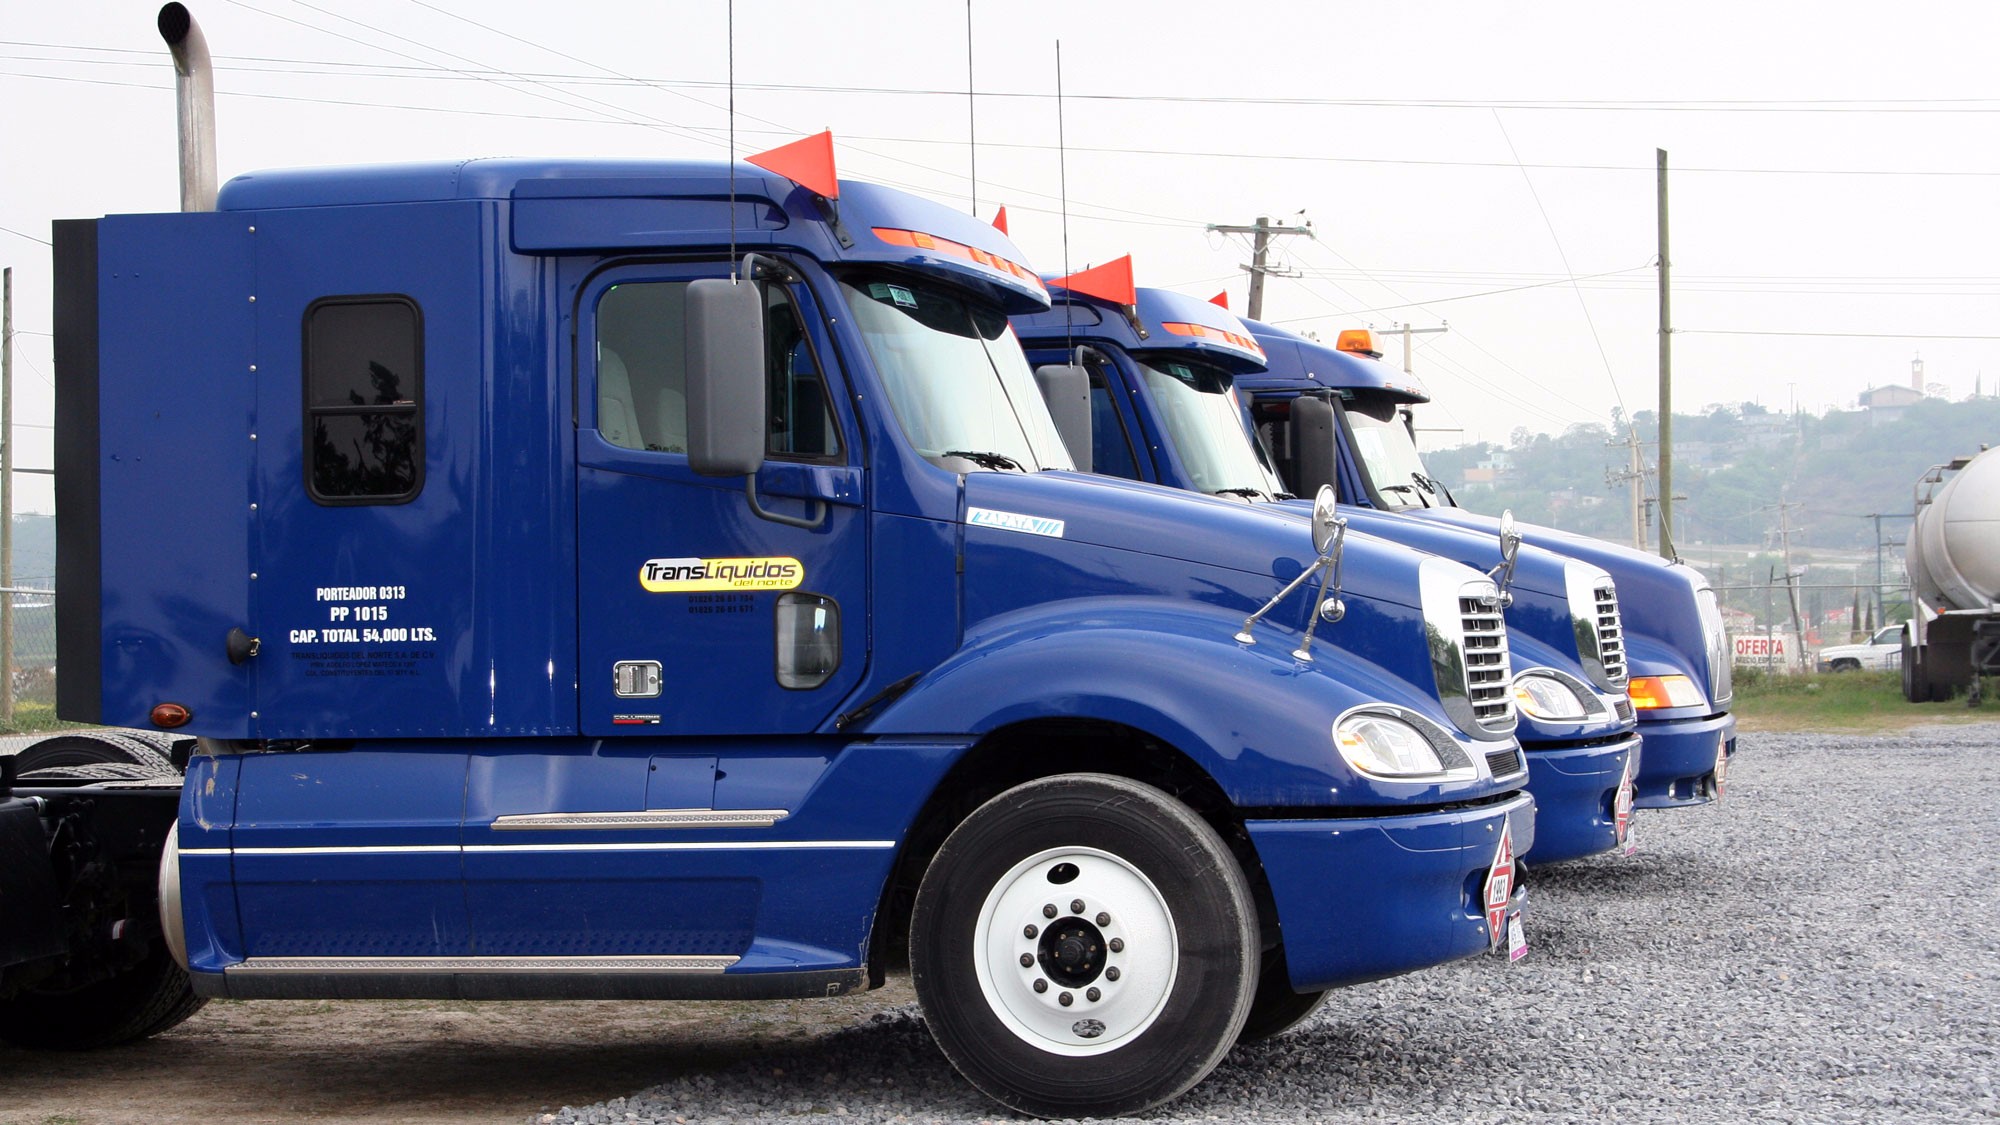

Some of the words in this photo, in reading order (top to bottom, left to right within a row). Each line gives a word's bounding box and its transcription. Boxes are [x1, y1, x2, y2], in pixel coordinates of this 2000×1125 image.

[975, 511, 1037, 532] ZAPATA
[645, 561, 797, 582] TransLíquidos
[734, 578, 752, 587] del
[758, 578, 793, 587] norte
[316, 587, 377, 601] PORTEADOR
[379, 586, 405, 600] 0313
[330, 607, 349, 621] PP
[354, 606, 388, 621] 1015
[290, 629, 319, 643] CAP.
[322, 629, 360, 643] TOTAL
[363, 628, 407, 643] 54,000
[411, 628, 437, 642] LTS.
[1736, 640, 1783, 654] OFERTA
[1494, 911, 1500, 932] 3
